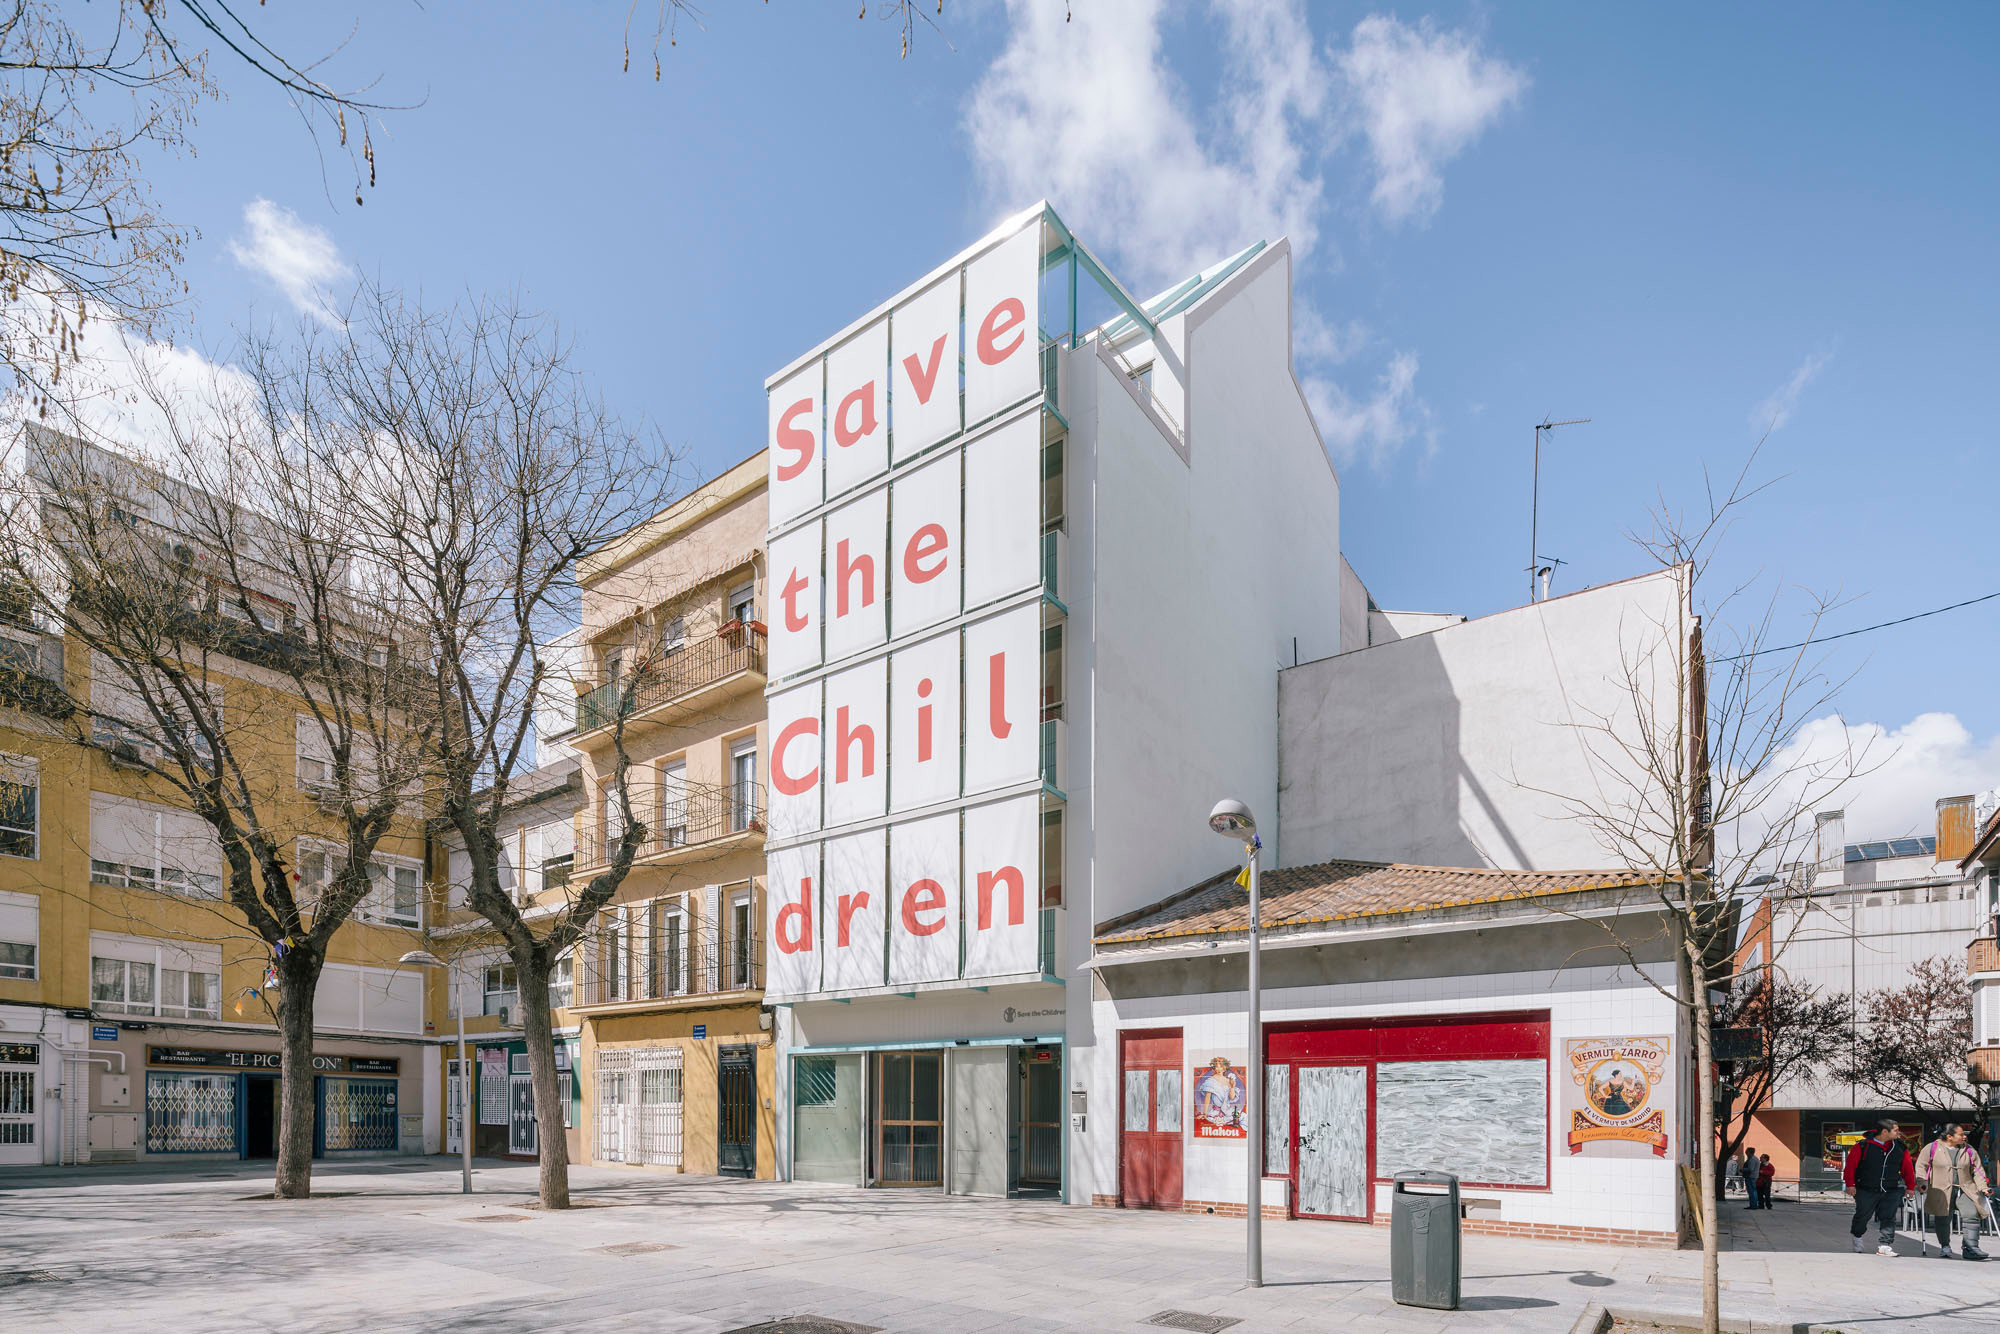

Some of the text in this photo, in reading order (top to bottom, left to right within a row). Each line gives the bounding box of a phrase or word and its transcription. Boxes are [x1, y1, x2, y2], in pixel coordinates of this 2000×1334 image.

[776, 297, 1026, 482] Save
[779, 523, 949, 633] the
[770, 651, 1012, 797] Chil
[775, 865, 1025, 955] dren
[1017, 1010, 1031, 1018] Save
[160, 1055, 206, 1063] RESTAURANTE
[1575, 1048, 1657, 1063] VERMUT ZARRO
[1584, 1106, 1593, 1116] EL
[1628, 1106, 1651, 1126] MADRID
[1201, 1126, 1240, 1137] Mahou
